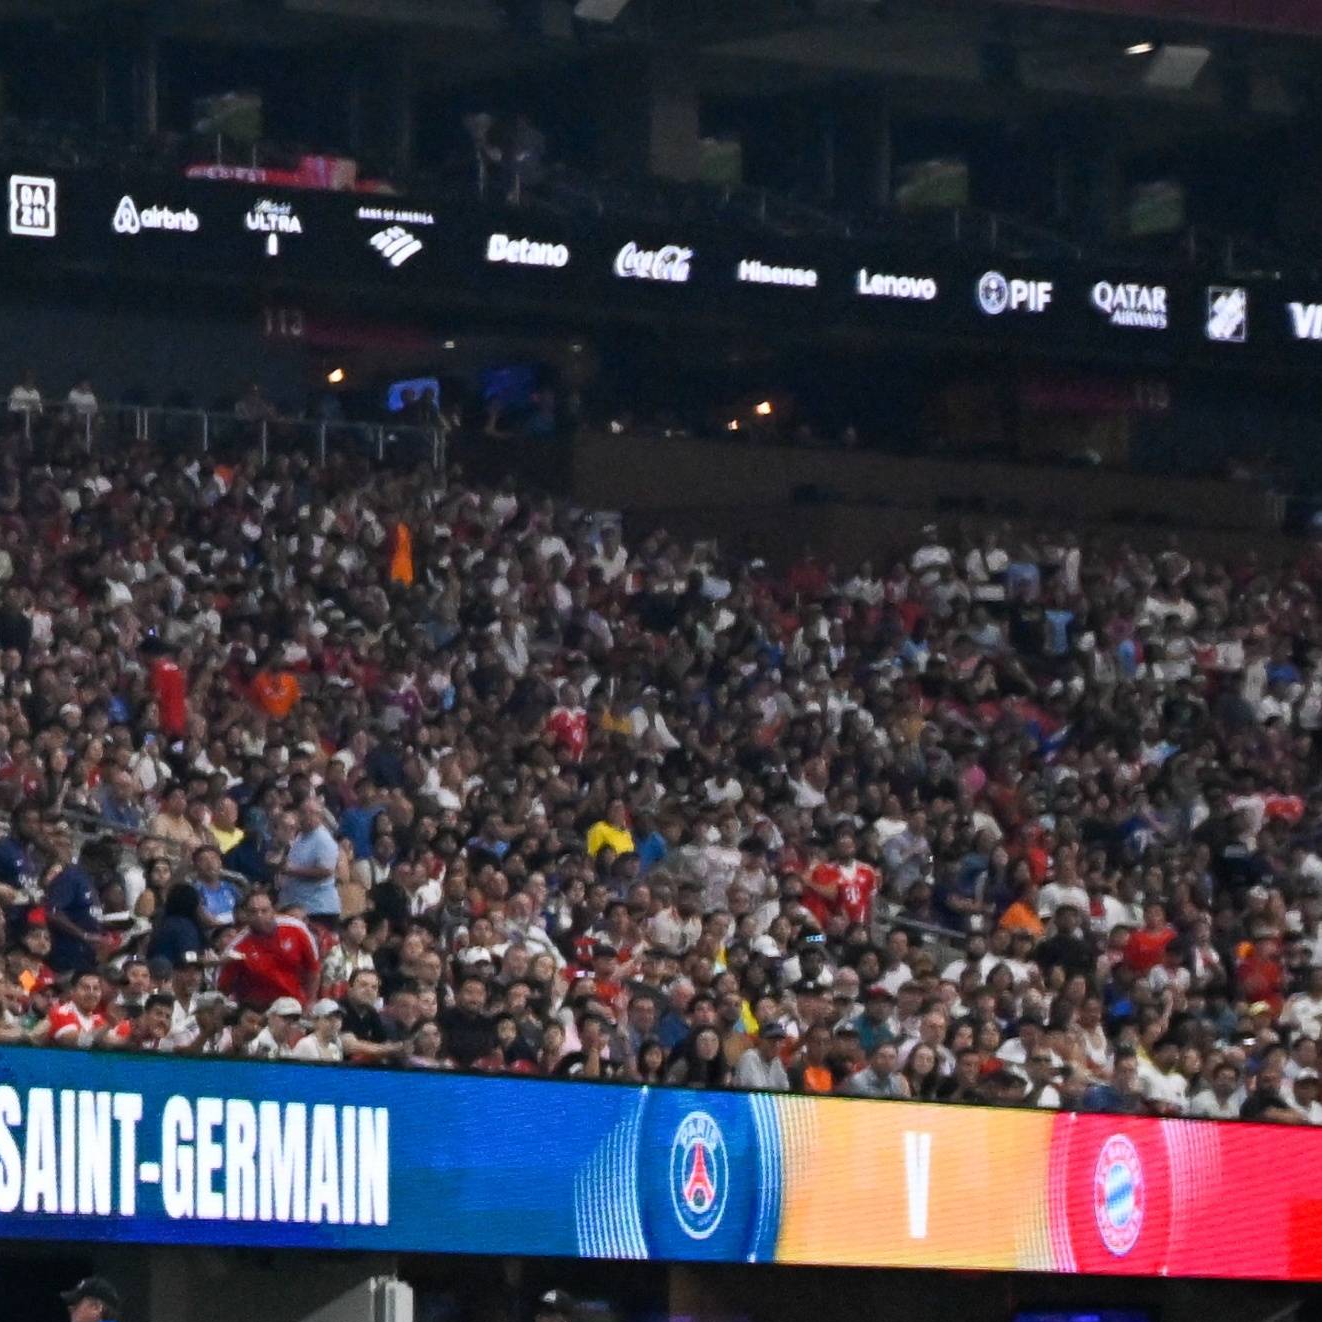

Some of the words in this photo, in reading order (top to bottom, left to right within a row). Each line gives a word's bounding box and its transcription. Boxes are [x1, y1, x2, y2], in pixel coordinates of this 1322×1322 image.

[140, 203, 200, 232] airbnb
[245, 211, 303, 234] ULTRA
[737, 259, 817, 287] Hisense
[857, 268, 937, 300] Lenovo
[1010, 279, 1053, 312] PIF
[1091, 281, 1167, 313] QATAR
[903, 1130, 933, 1239] V
